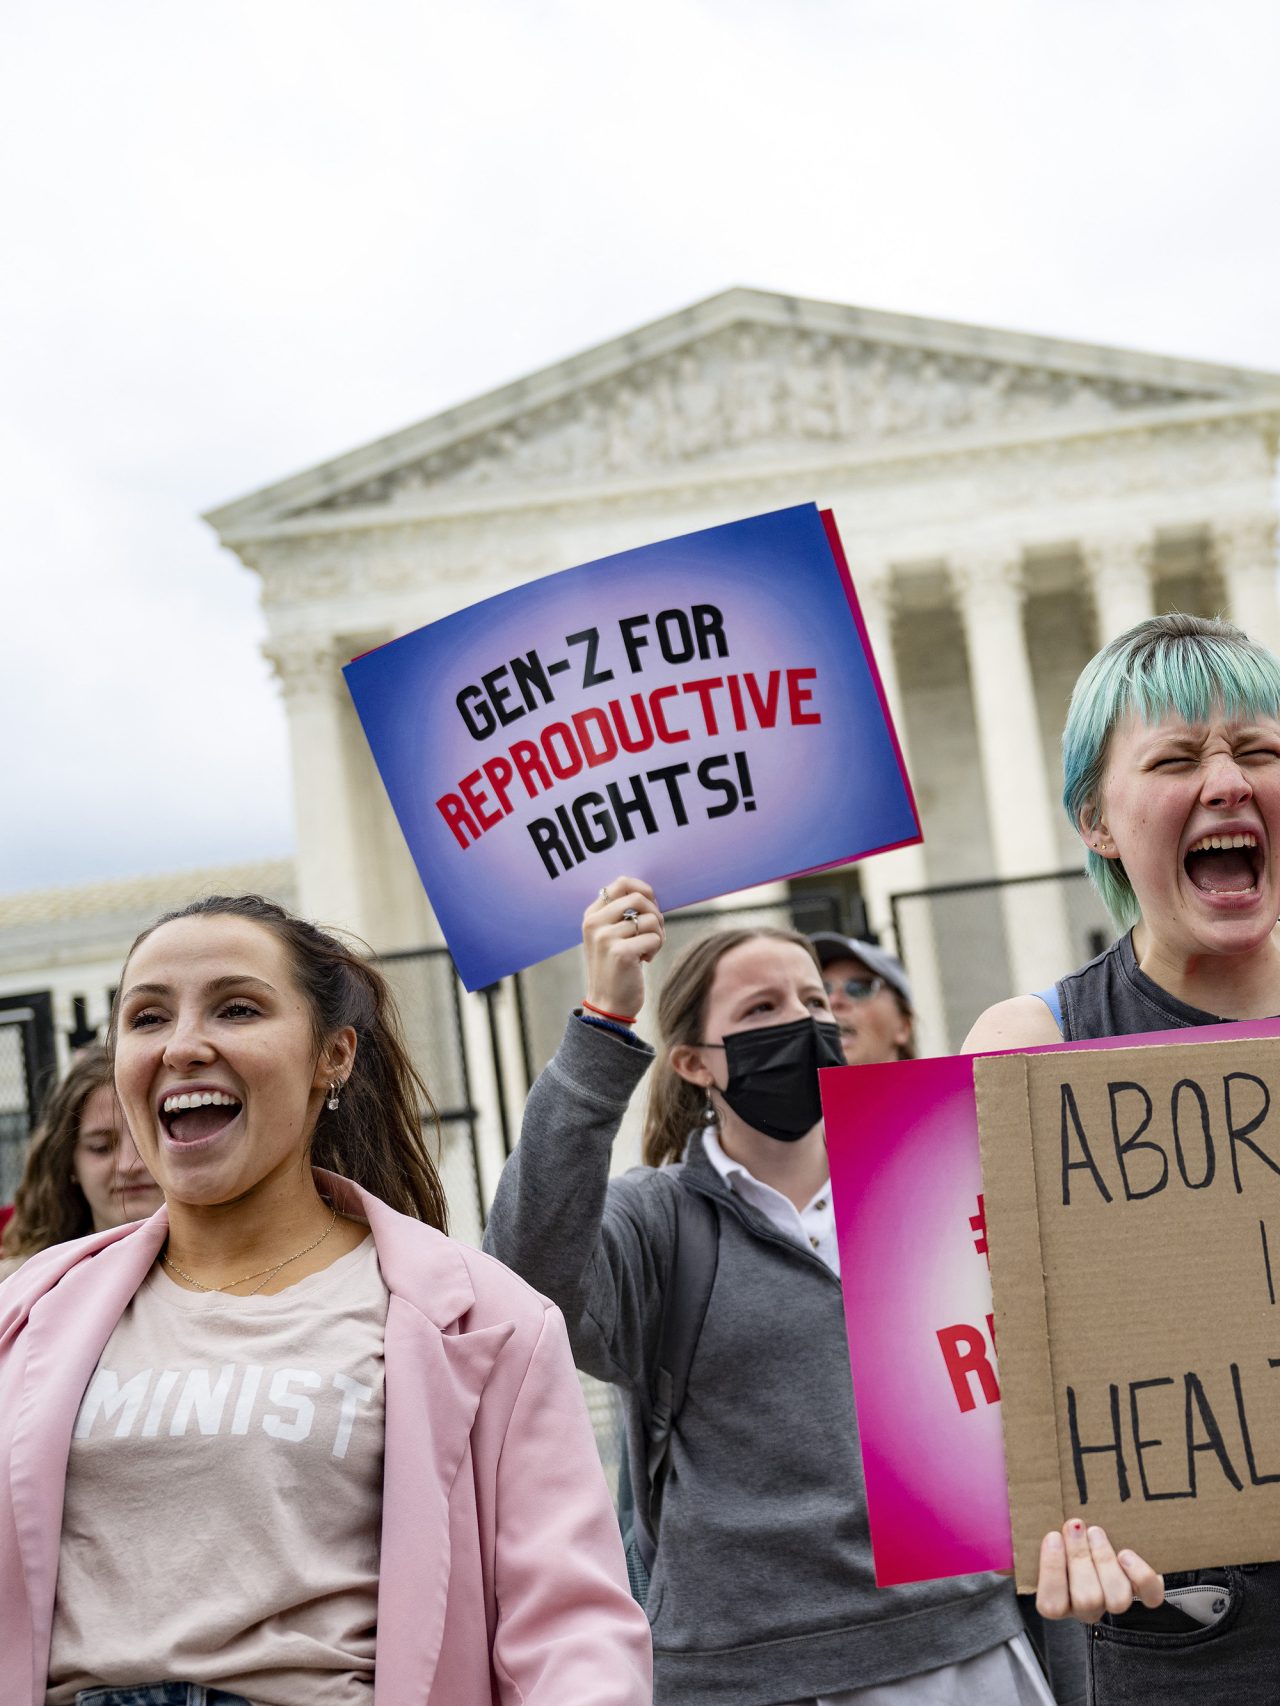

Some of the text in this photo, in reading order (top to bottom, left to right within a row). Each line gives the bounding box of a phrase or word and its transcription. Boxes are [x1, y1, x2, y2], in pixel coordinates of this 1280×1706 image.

[455, 603, 730, 742] GEN-Z FOR
[436, 667, 821, 849] REPRODUCTIVE
[526, 751, 757, 880] RIGHTS!
